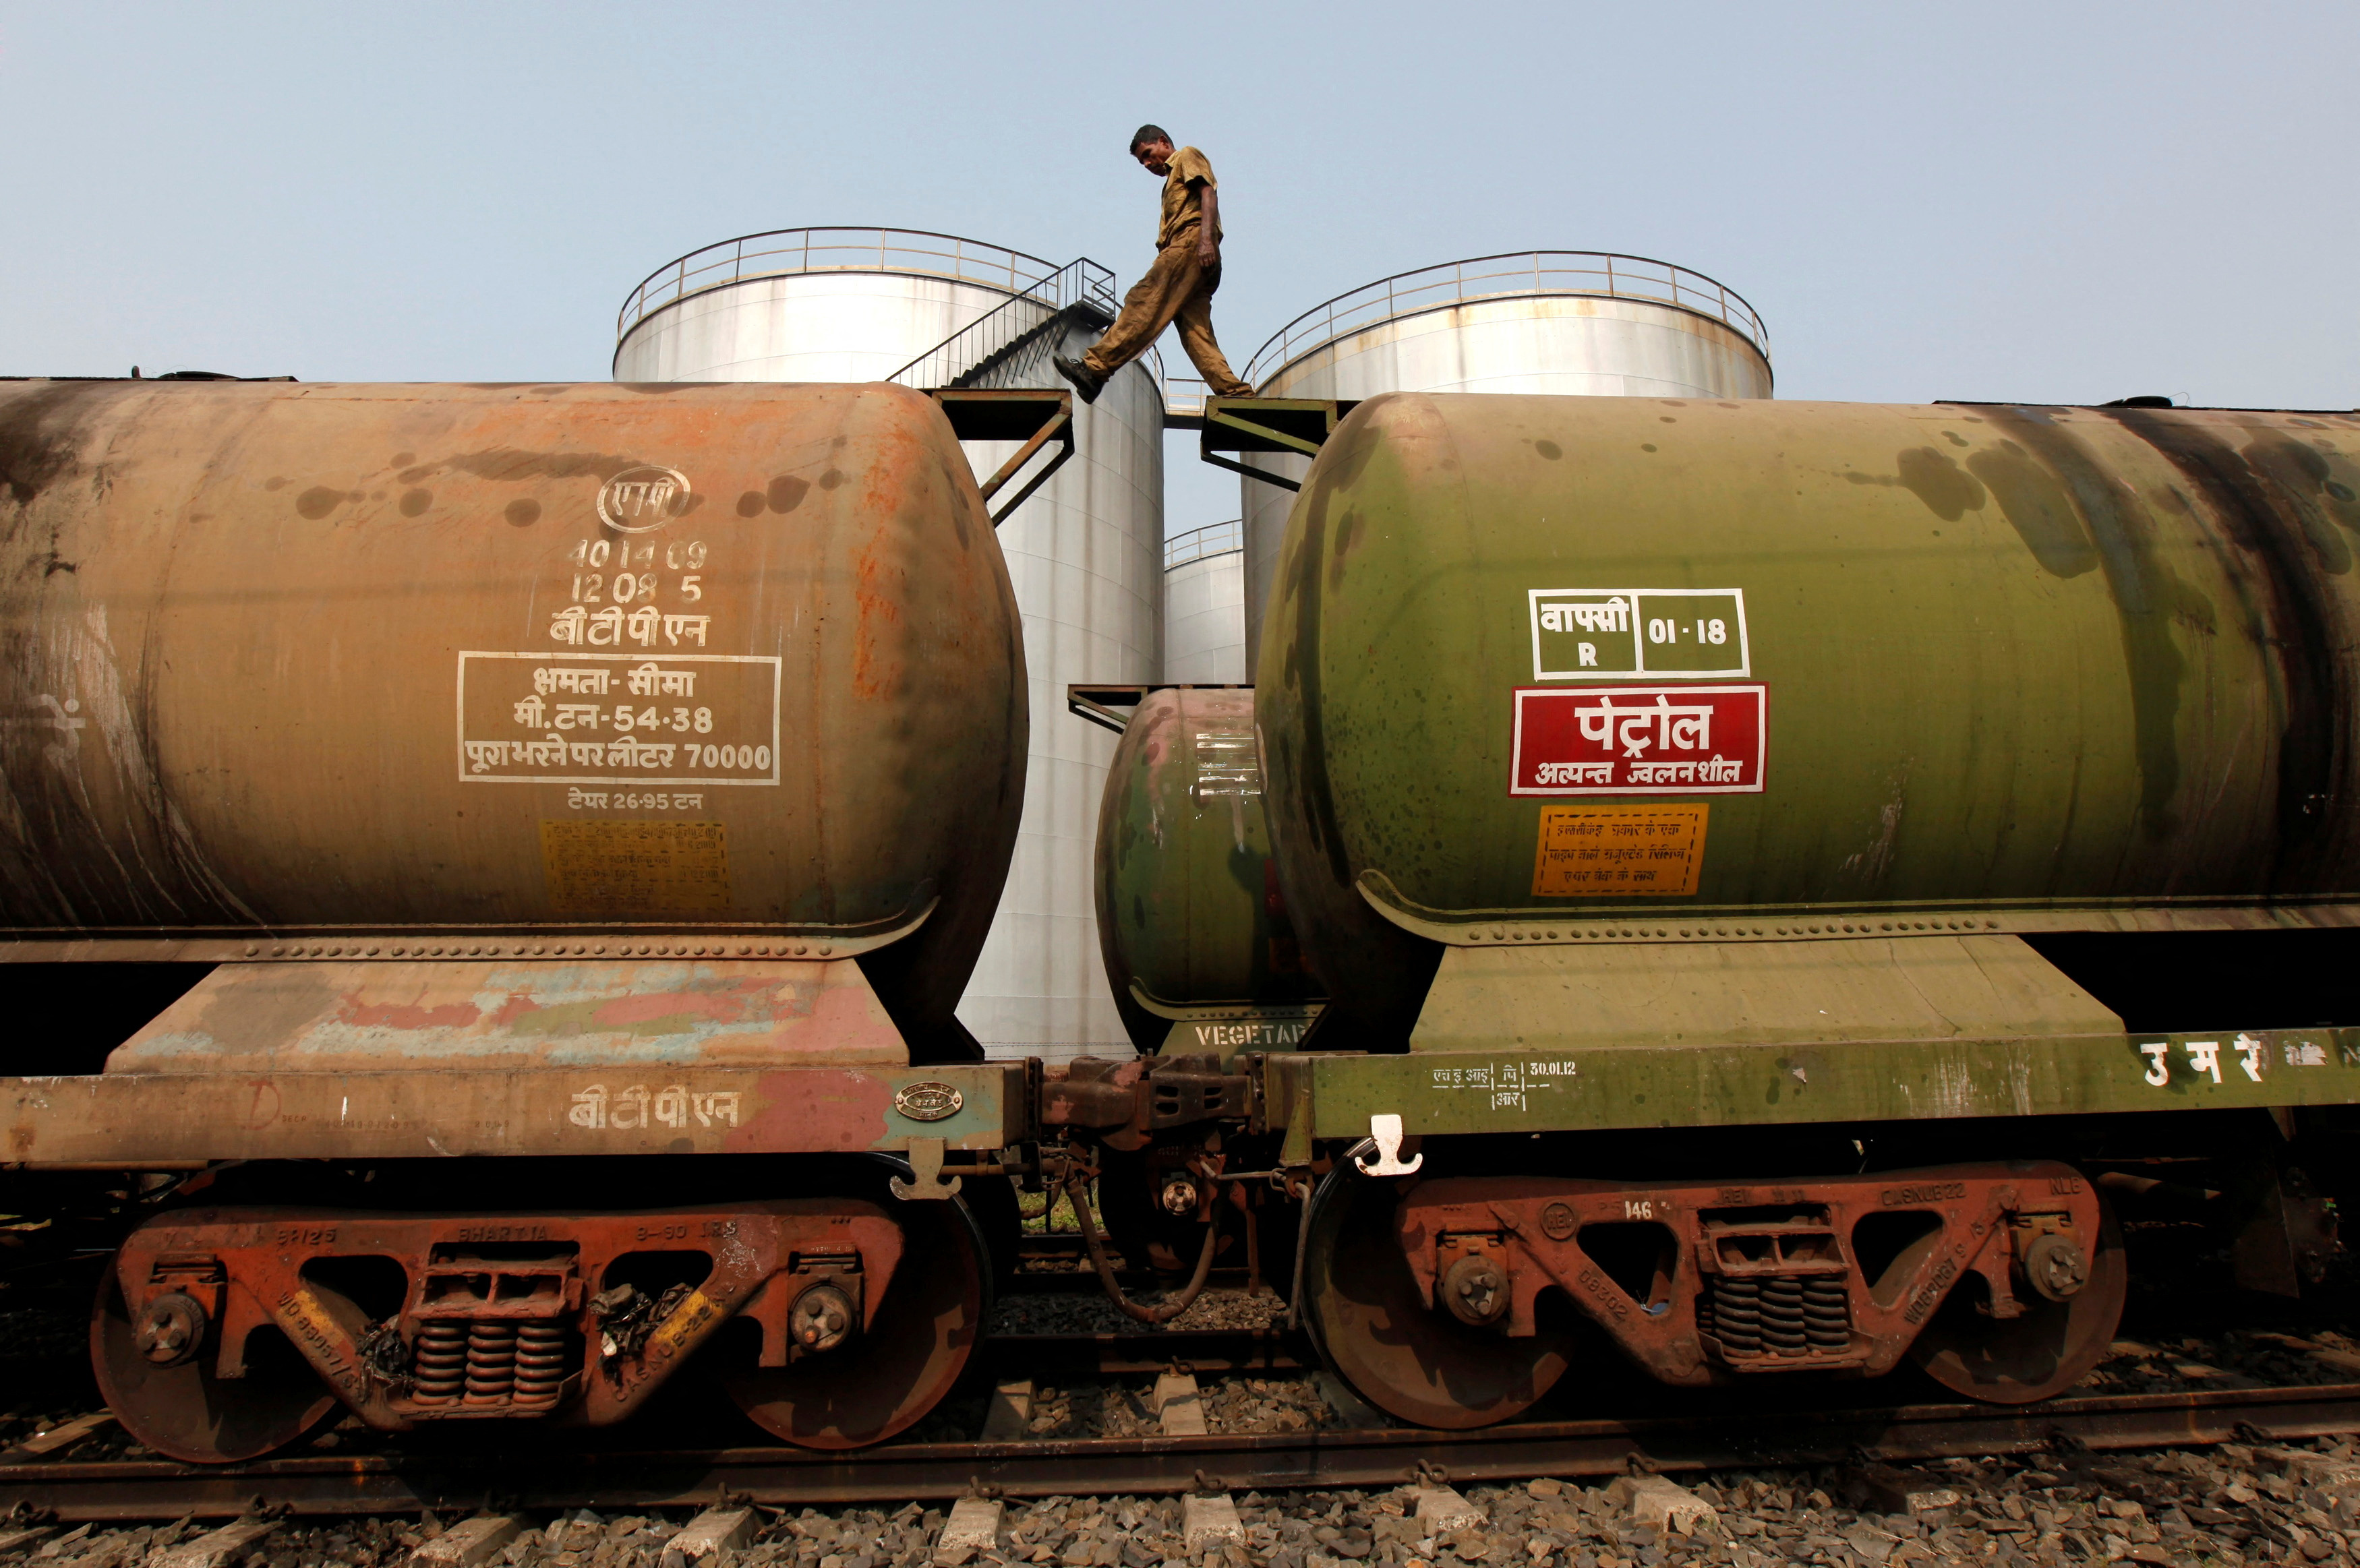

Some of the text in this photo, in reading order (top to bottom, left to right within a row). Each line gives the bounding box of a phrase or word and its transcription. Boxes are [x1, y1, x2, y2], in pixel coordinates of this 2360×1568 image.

[1578, 642, 1598, 667] R
[1574, 694, 1714, 758] पेट्रोल
[684, 744, 771, 771] 70000
[1535, 754, 1744, 785] अत्यन्त ज्वलनशील
[673, 793, 703, 810] टन
[568, 1083, 742, 1129] बीटीपीएन
